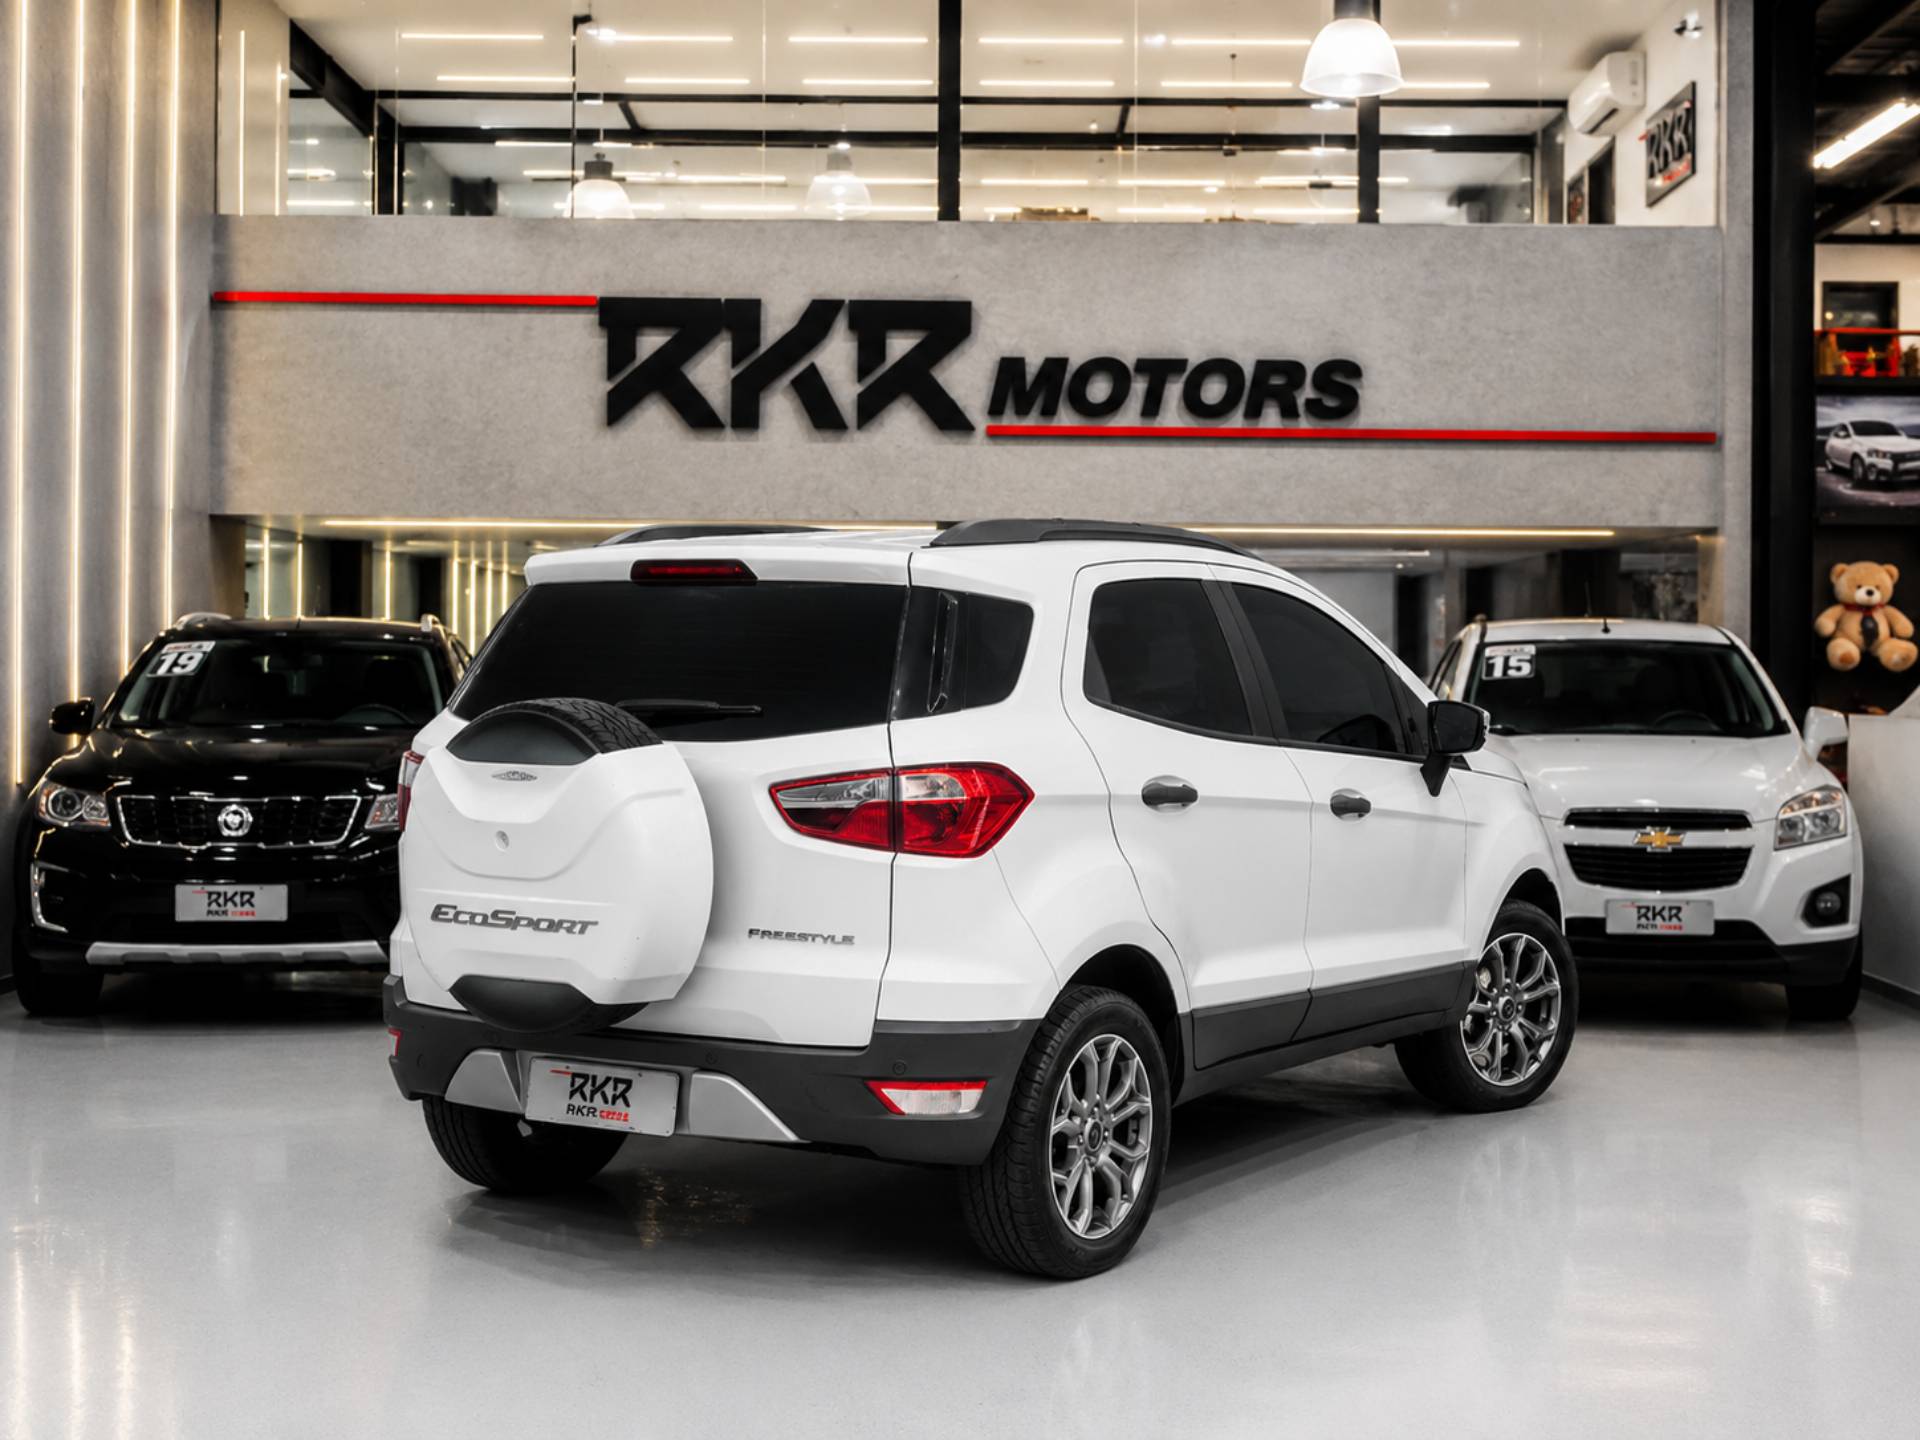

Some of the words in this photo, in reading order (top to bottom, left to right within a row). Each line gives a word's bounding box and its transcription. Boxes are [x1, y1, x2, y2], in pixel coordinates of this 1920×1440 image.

[599, 297, 975, 431] RKR
[988, 356, 1363, 420] MOTORS
[157, 652, 203, 675] 19
[1488, 655, 1531, 677] 15
[207, 891, 255, 908] RKR
[1637, 906, 1682, 922] RKR
[748, 928, 855, 945] FREESTYLE
[569, 1072, 633, 1108] RKR
[566, 1103, 598, 1118] RKR
